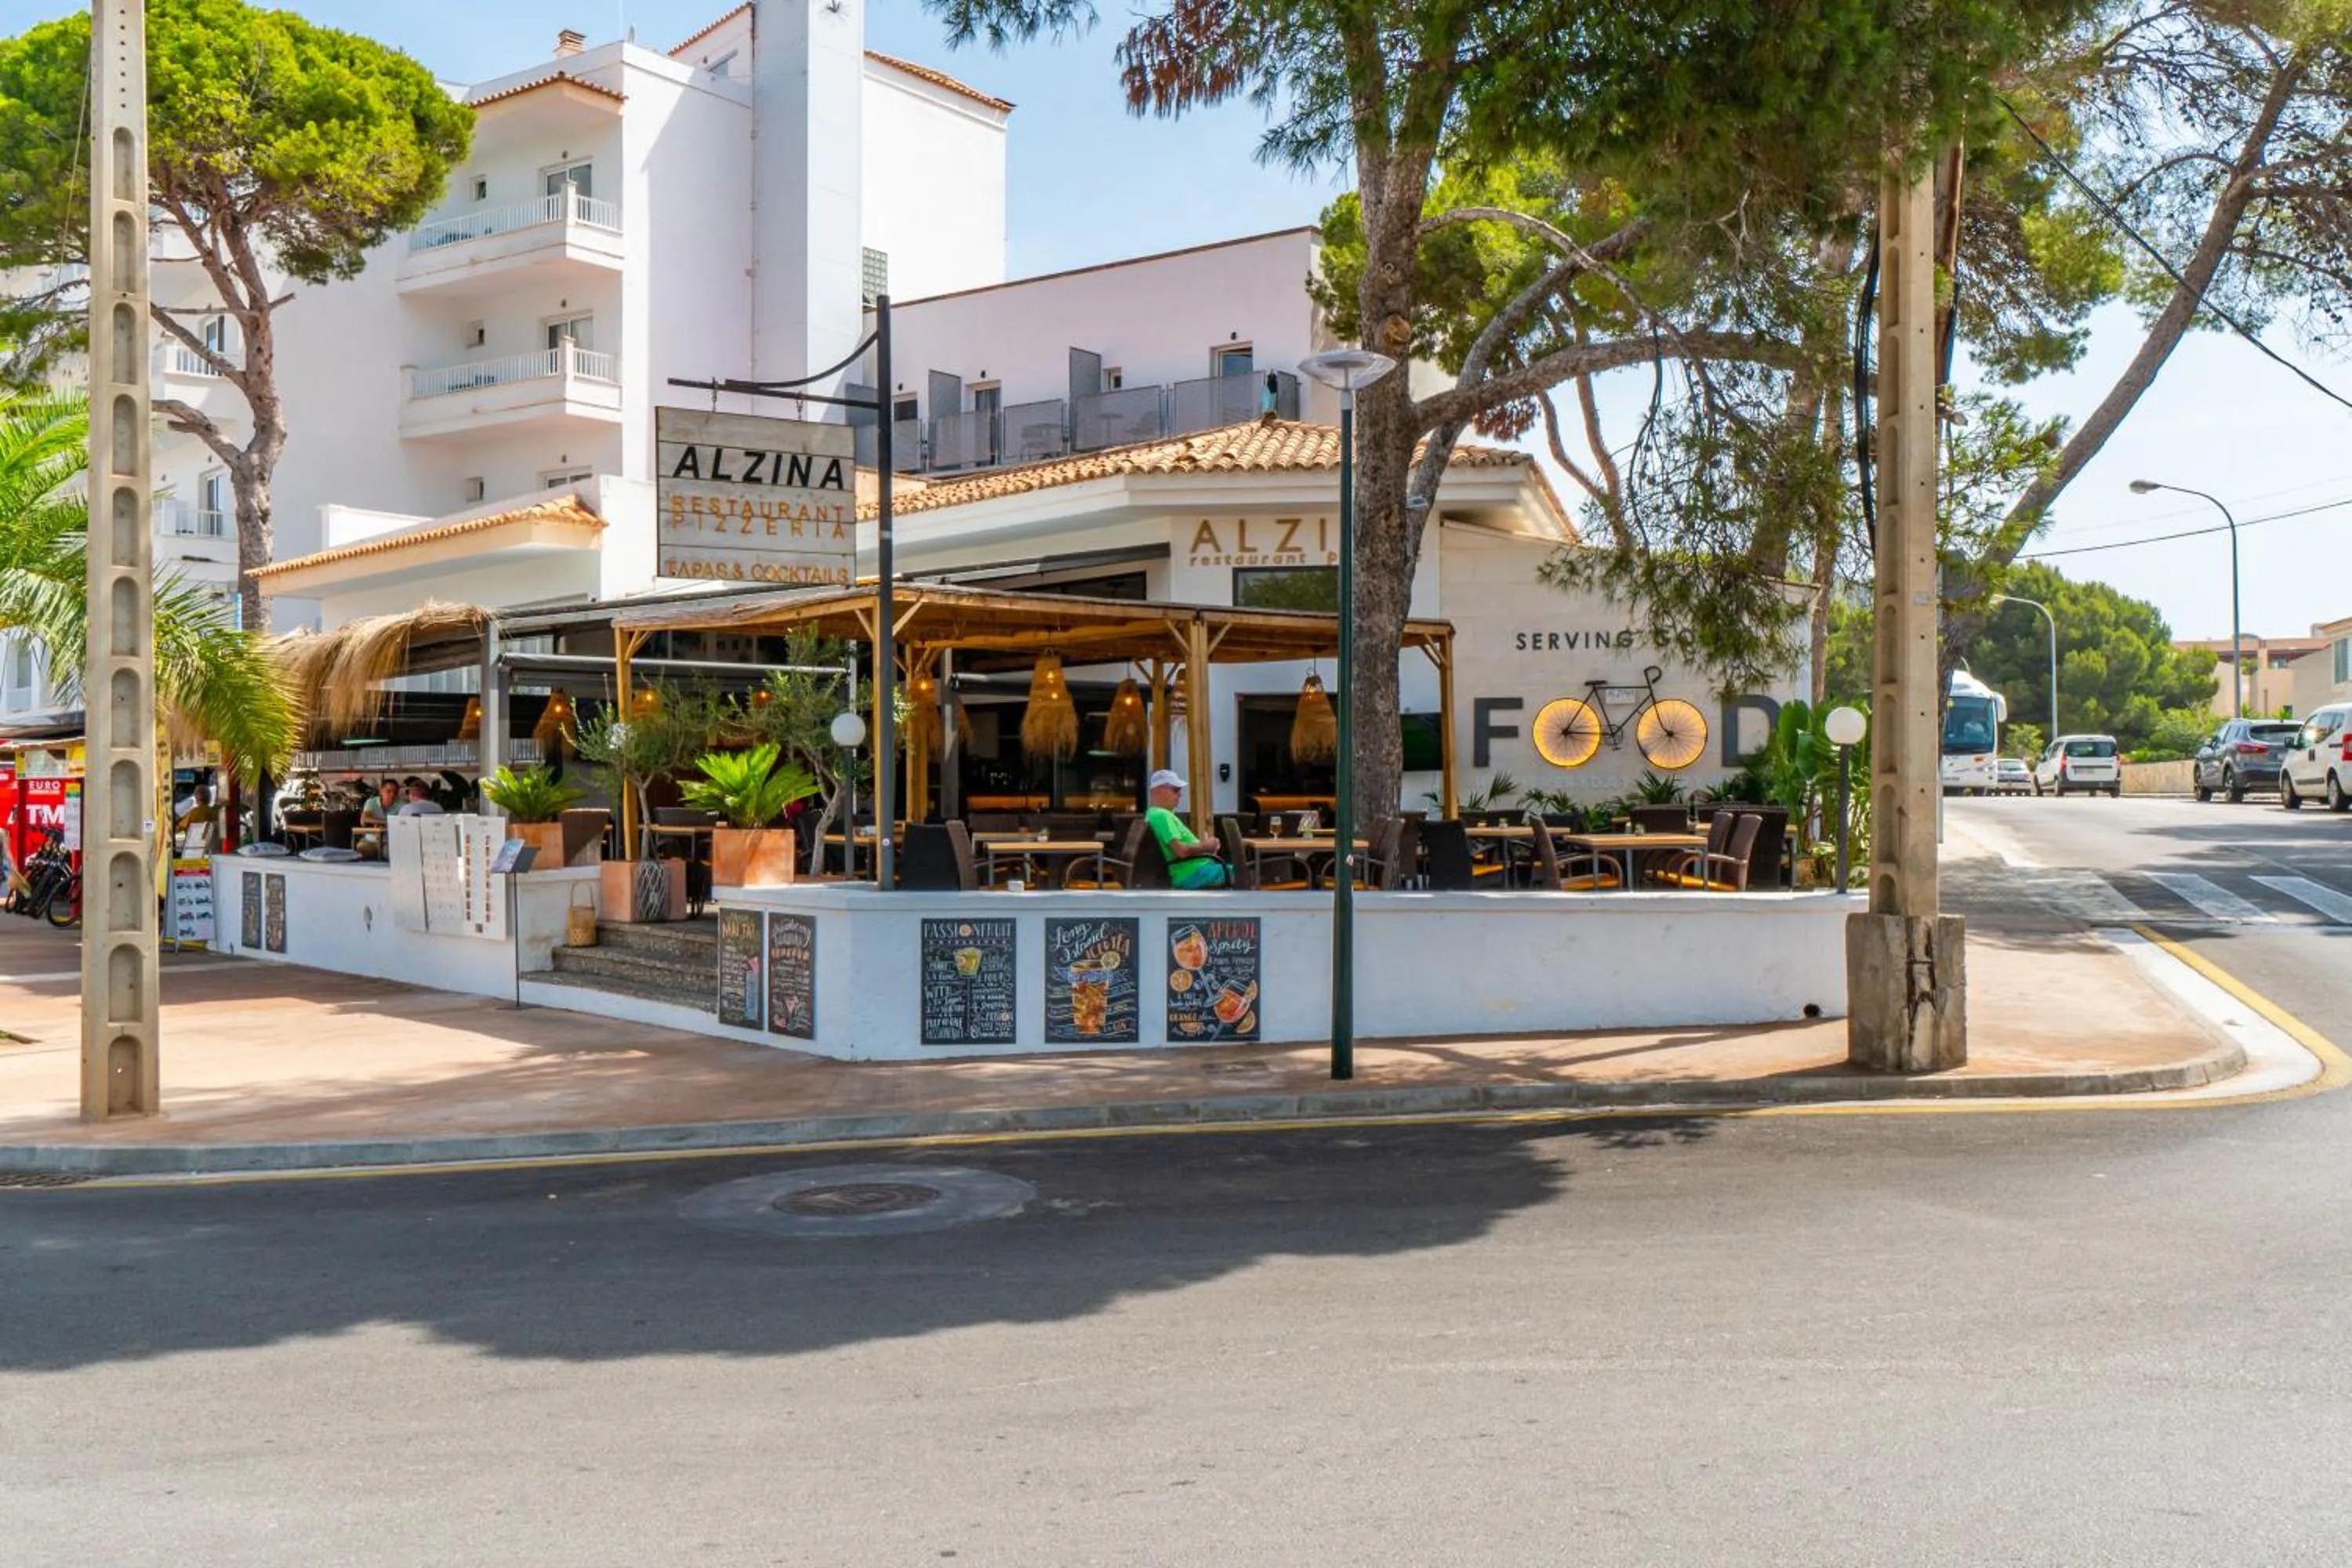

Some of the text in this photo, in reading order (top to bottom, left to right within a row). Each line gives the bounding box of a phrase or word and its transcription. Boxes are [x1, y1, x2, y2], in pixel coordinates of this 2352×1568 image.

[673, 446, 844, 489] ALZINA
[671, 495, 844, 522] RESTAURANT
[672, 512, 845, 539] PIZZERIA
[1190, 517, 1327, 553] ALZI
[666, 560, 849, 583] TAPAS & COCKTAILS
[1189, 552, 1307, 566] restaurant
[1515, 630, 1634, 651] SERVING
[28, 780, 61, 789] EURO
[1048, 922, 1092, 953] Long
